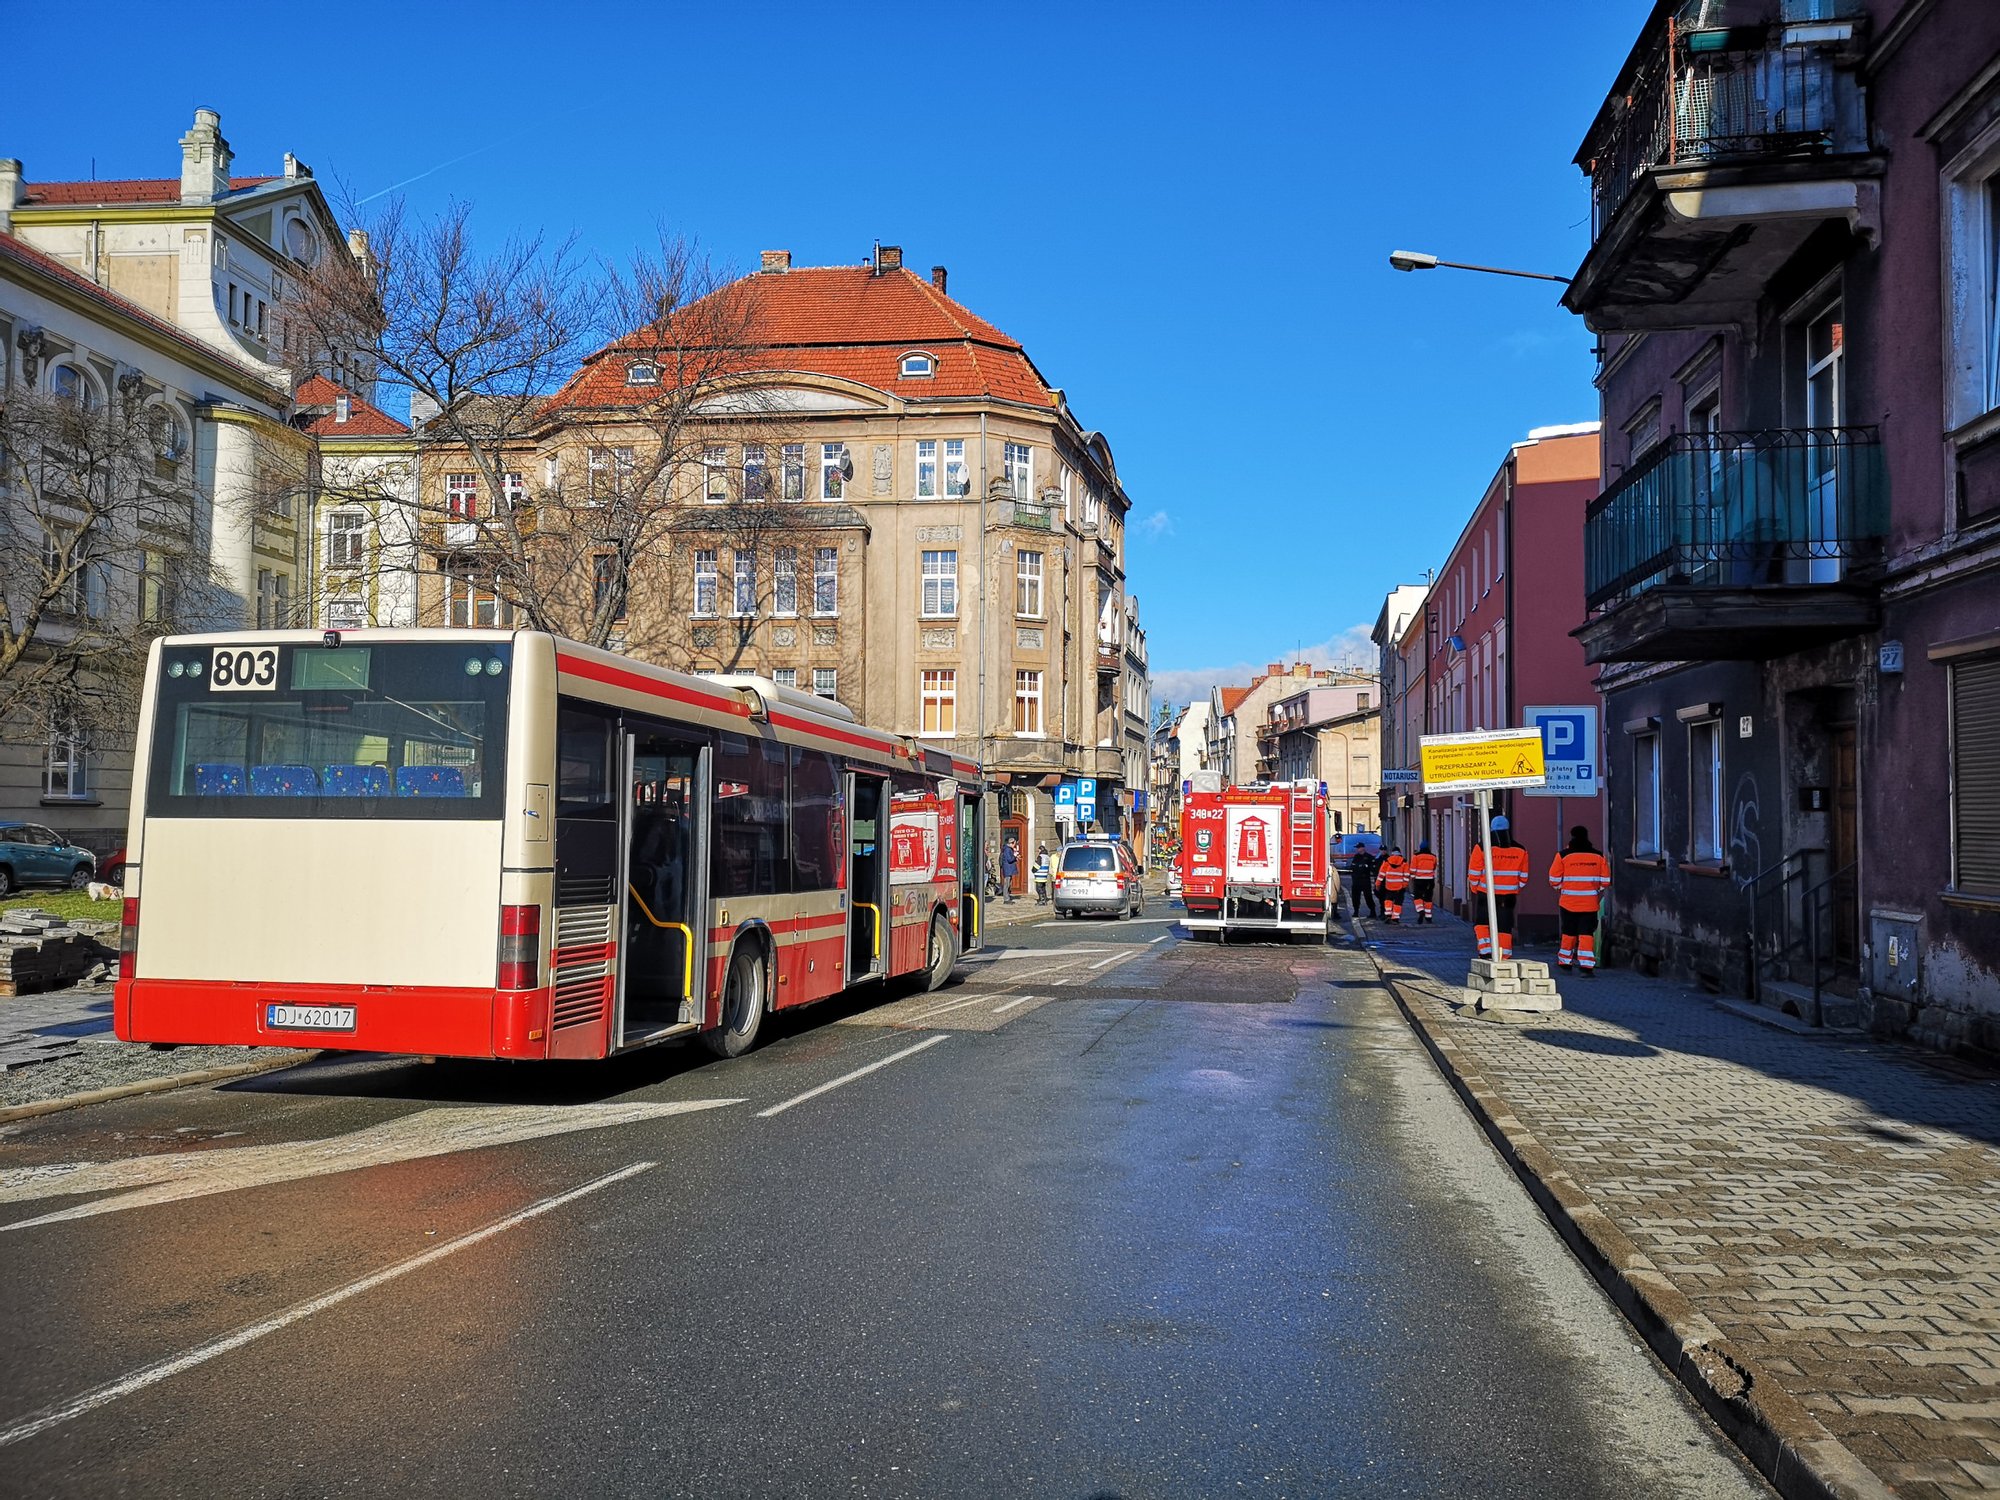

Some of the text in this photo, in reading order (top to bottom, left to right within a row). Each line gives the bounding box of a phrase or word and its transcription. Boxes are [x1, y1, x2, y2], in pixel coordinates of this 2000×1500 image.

[1882, 652, 1899, 665] 27
[213, 650, 276, 686] 803
[1547, 720, 1575, 755] P
[1435, 762, 1486, 770] PRZEPRASZAMY
[1384, 772, 1418, 780] NOTARIUSZ
[1429, 771, 1473, 779] UTRUDNIENIA
[1058, 788, 1071, 803] P
[1081, 781, 1093, 796] P
[1080, 805, 1092, 820] P
